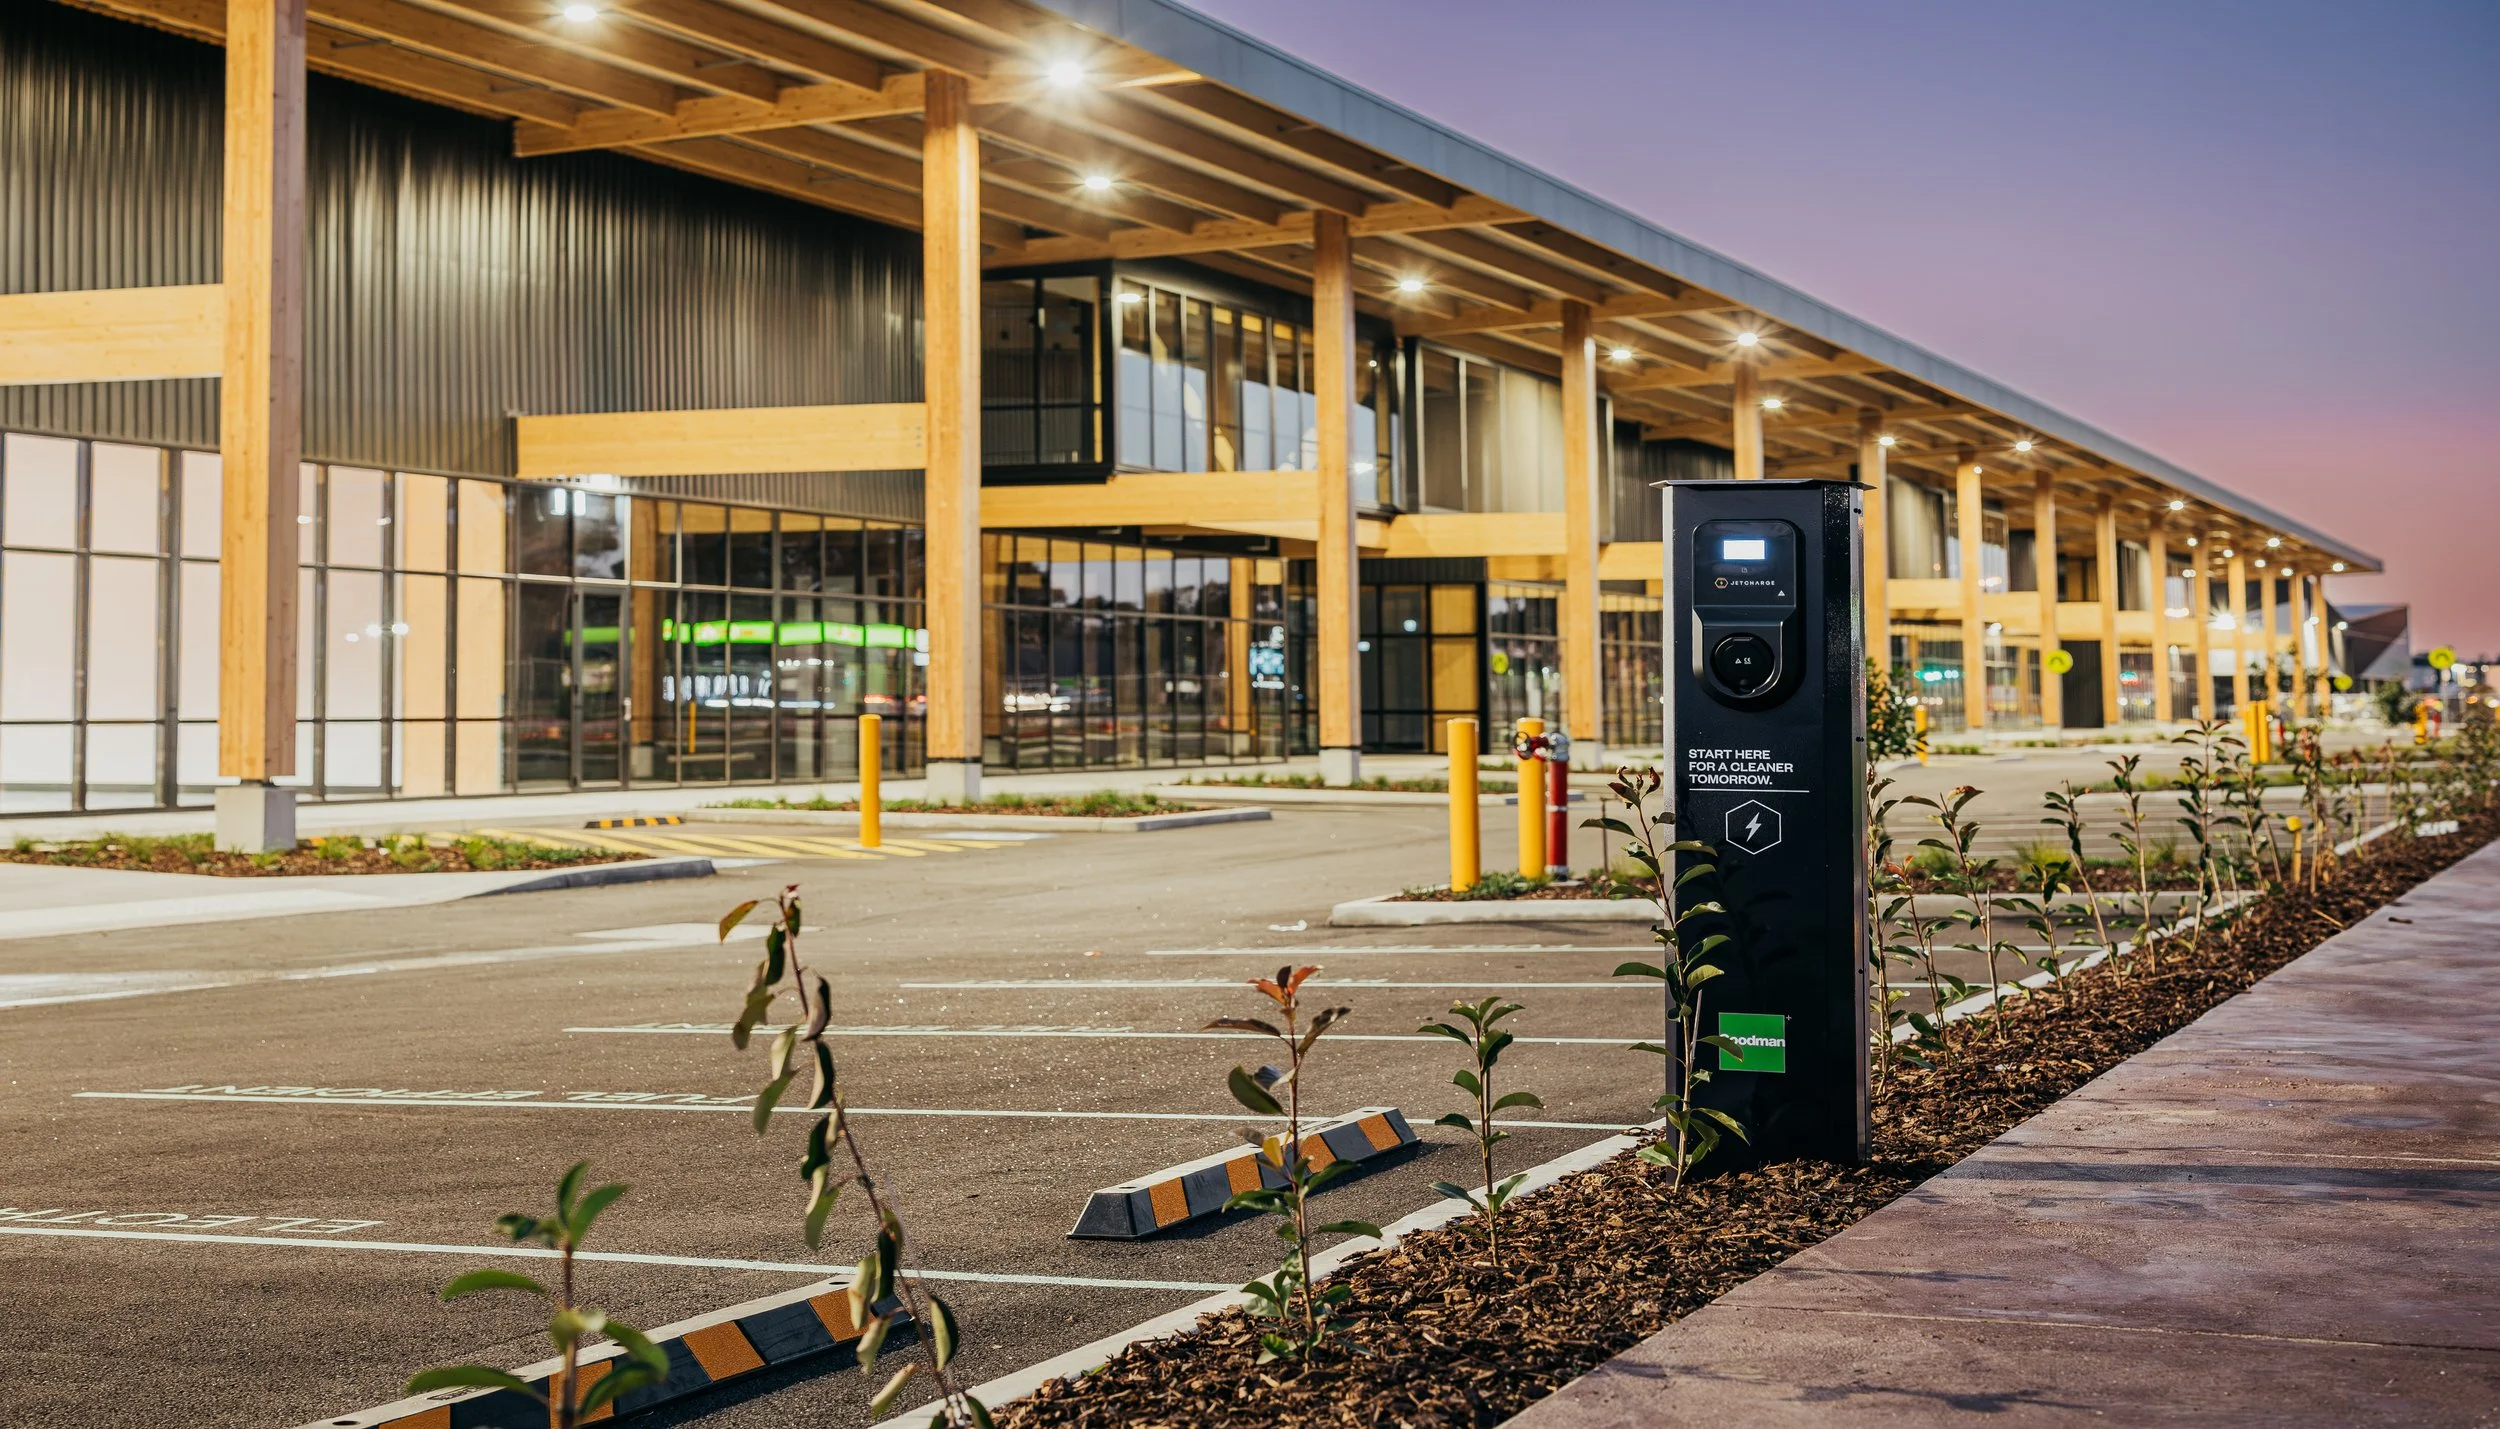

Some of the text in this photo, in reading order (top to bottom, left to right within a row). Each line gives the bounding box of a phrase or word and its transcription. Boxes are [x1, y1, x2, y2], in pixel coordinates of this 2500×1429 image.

[1688, 748, 1771, 760] START HERE
[1688, 761, 1794, 773] FOR A CLEANER
[1688, 774, 1773, 785] TOMORROW.
